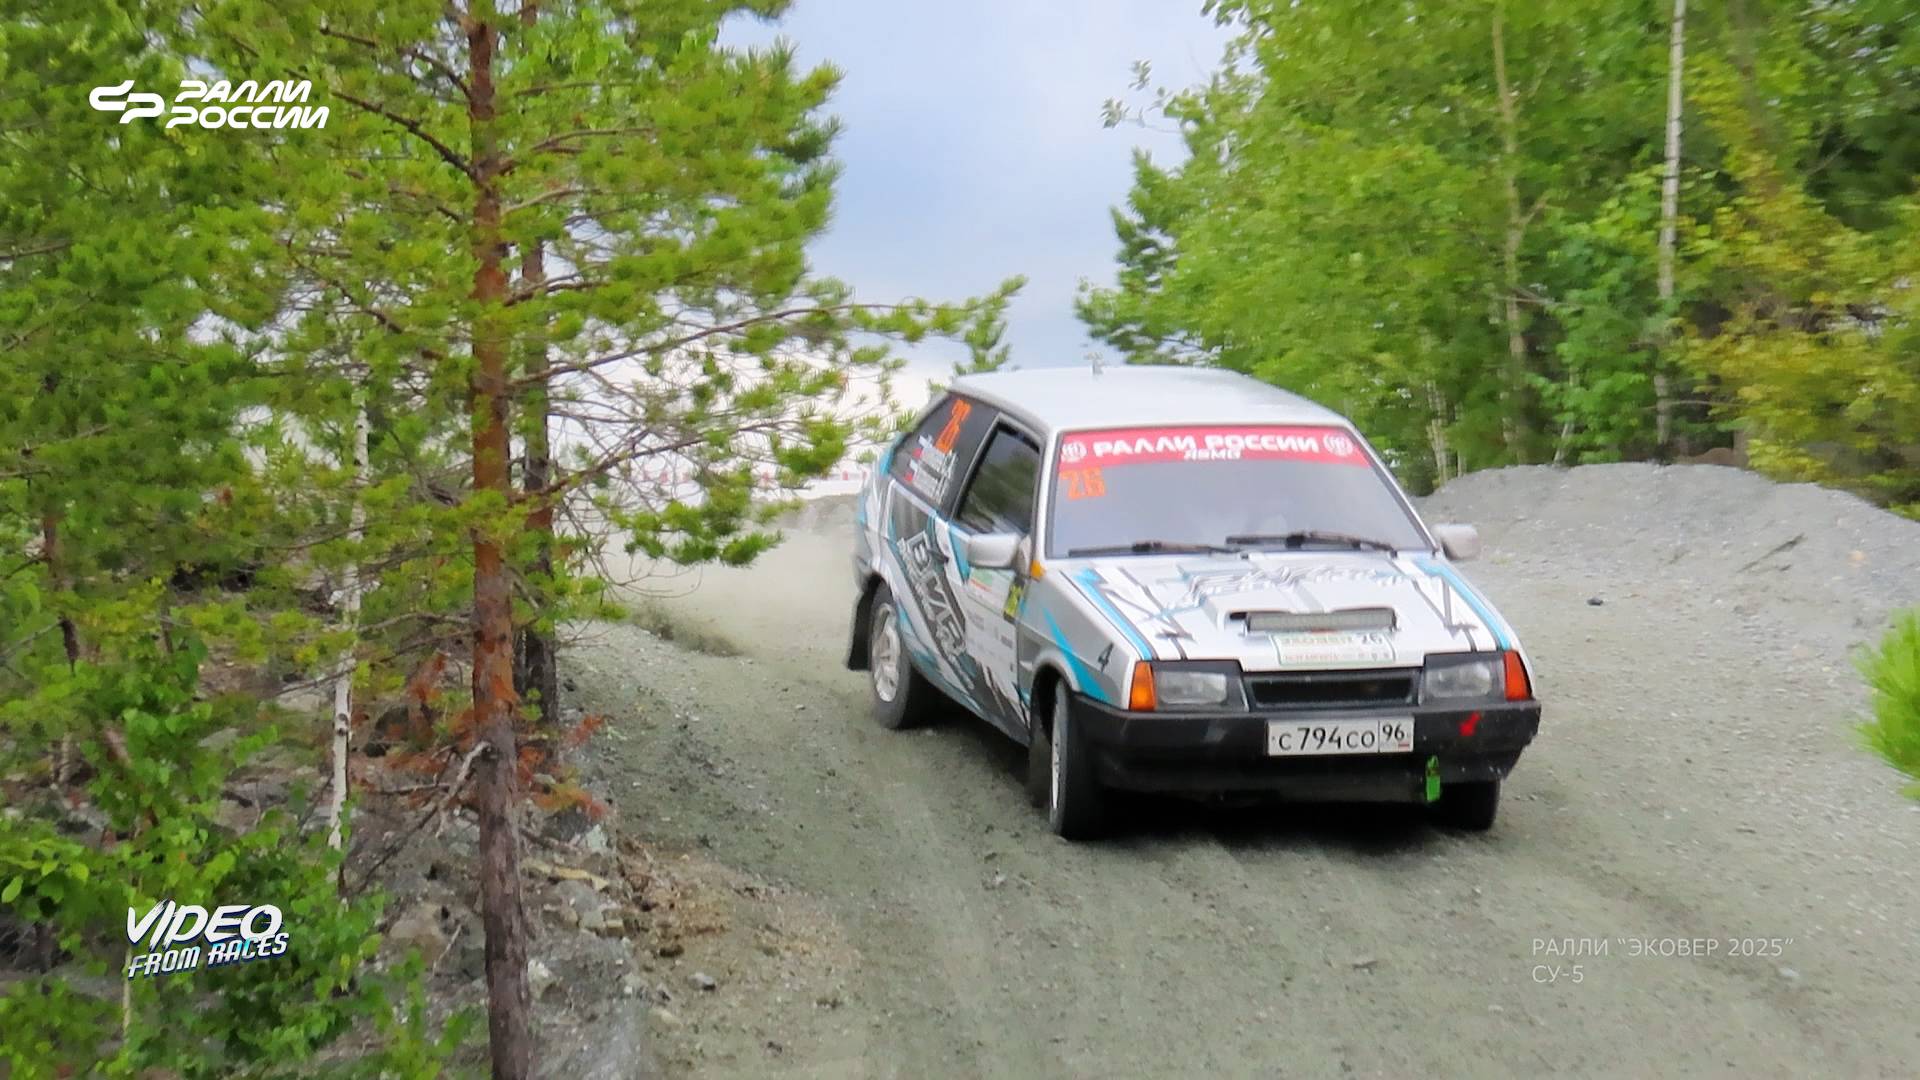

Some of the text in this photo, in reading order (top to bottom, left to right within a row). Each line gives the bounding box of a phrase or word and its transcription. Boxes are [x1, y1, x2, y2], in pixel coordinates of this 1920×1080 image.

[1093, 435, 1319, 457] РАЛЛИ РОССИИ
[1062, 468, 1106, 500] 26
